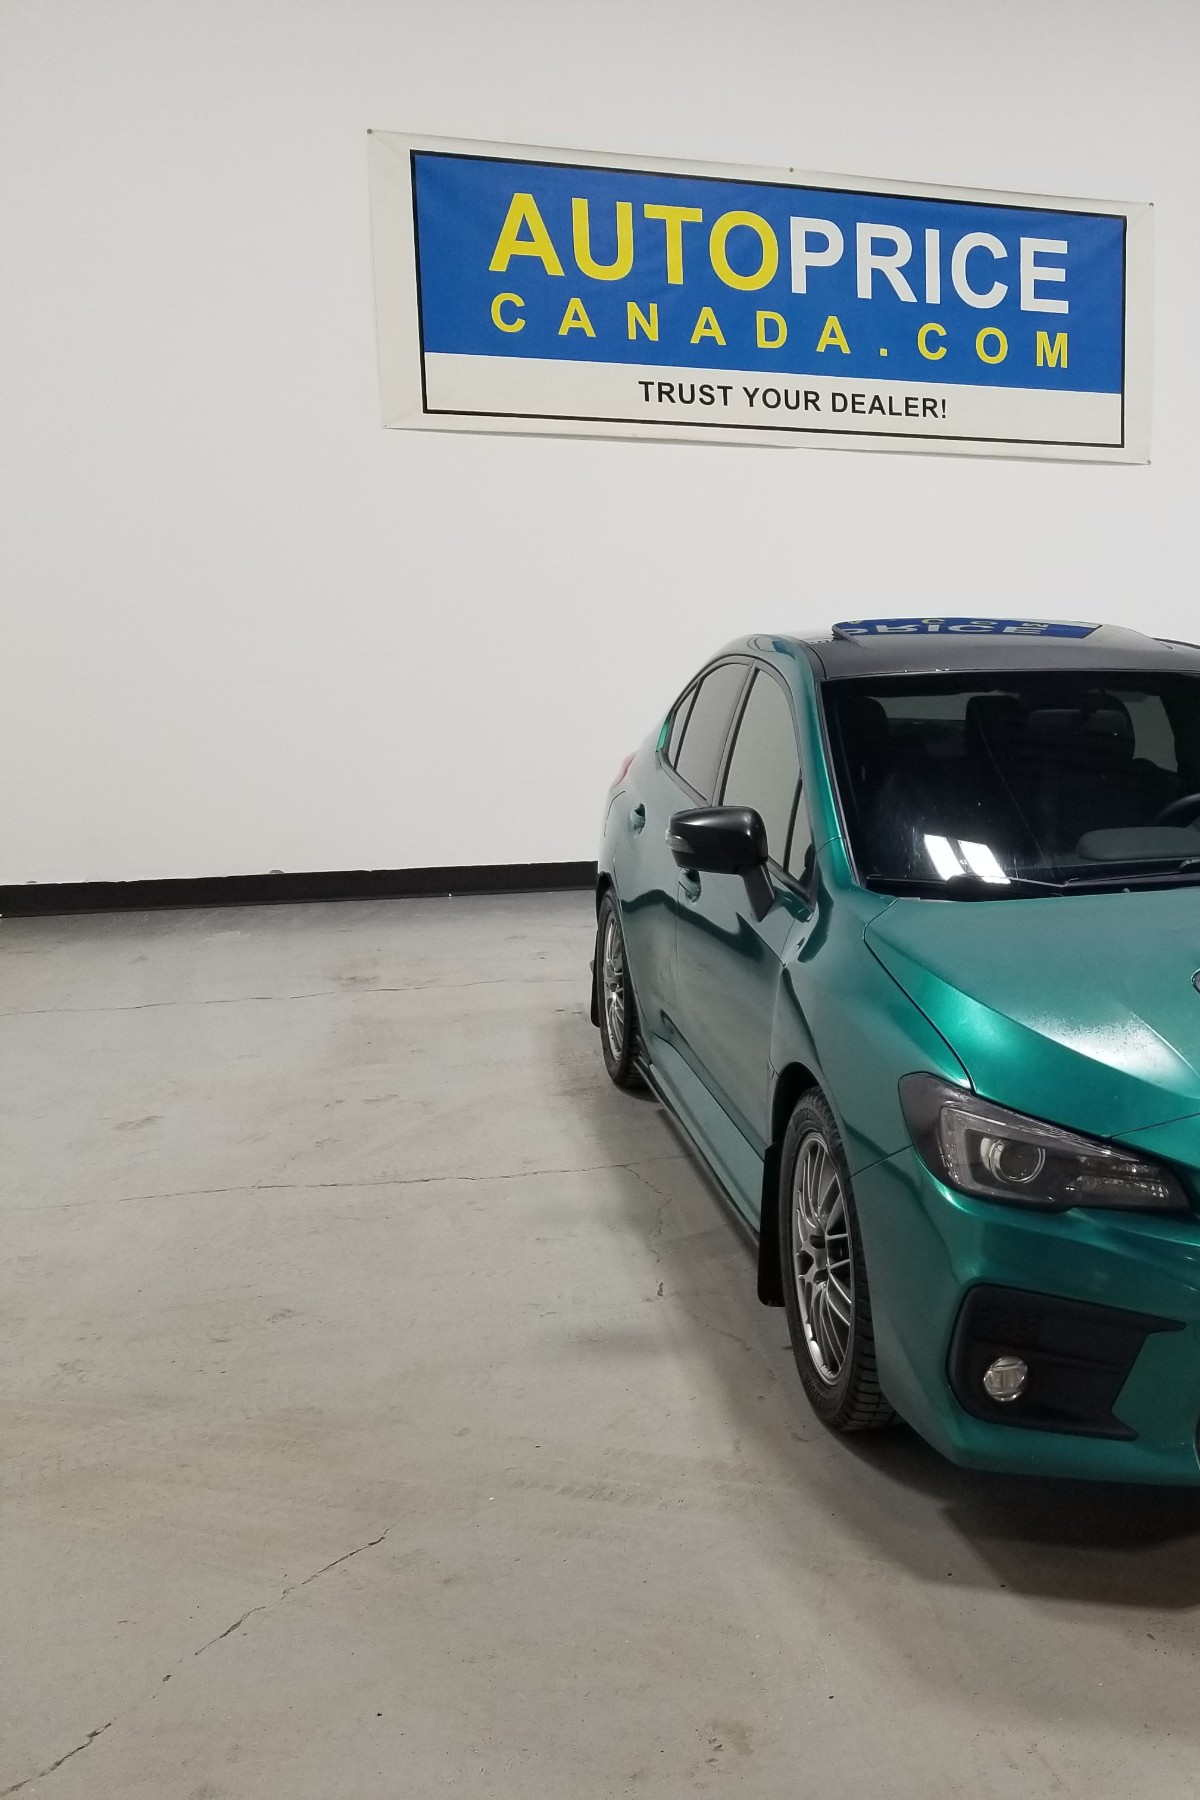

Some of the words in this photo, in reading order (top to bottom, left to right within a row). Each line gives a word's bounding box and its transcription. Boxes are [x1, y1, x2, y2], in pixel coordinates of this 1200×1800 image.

[488, 192, 1069, 315] AUTOPRICE
[490, 292, 1068, 369] CANADA.COM
[638, 380, 734, 407] TRUST
[742, 386, 822, 412] YOUR
[831, 392, 947, 418] DEALER!
